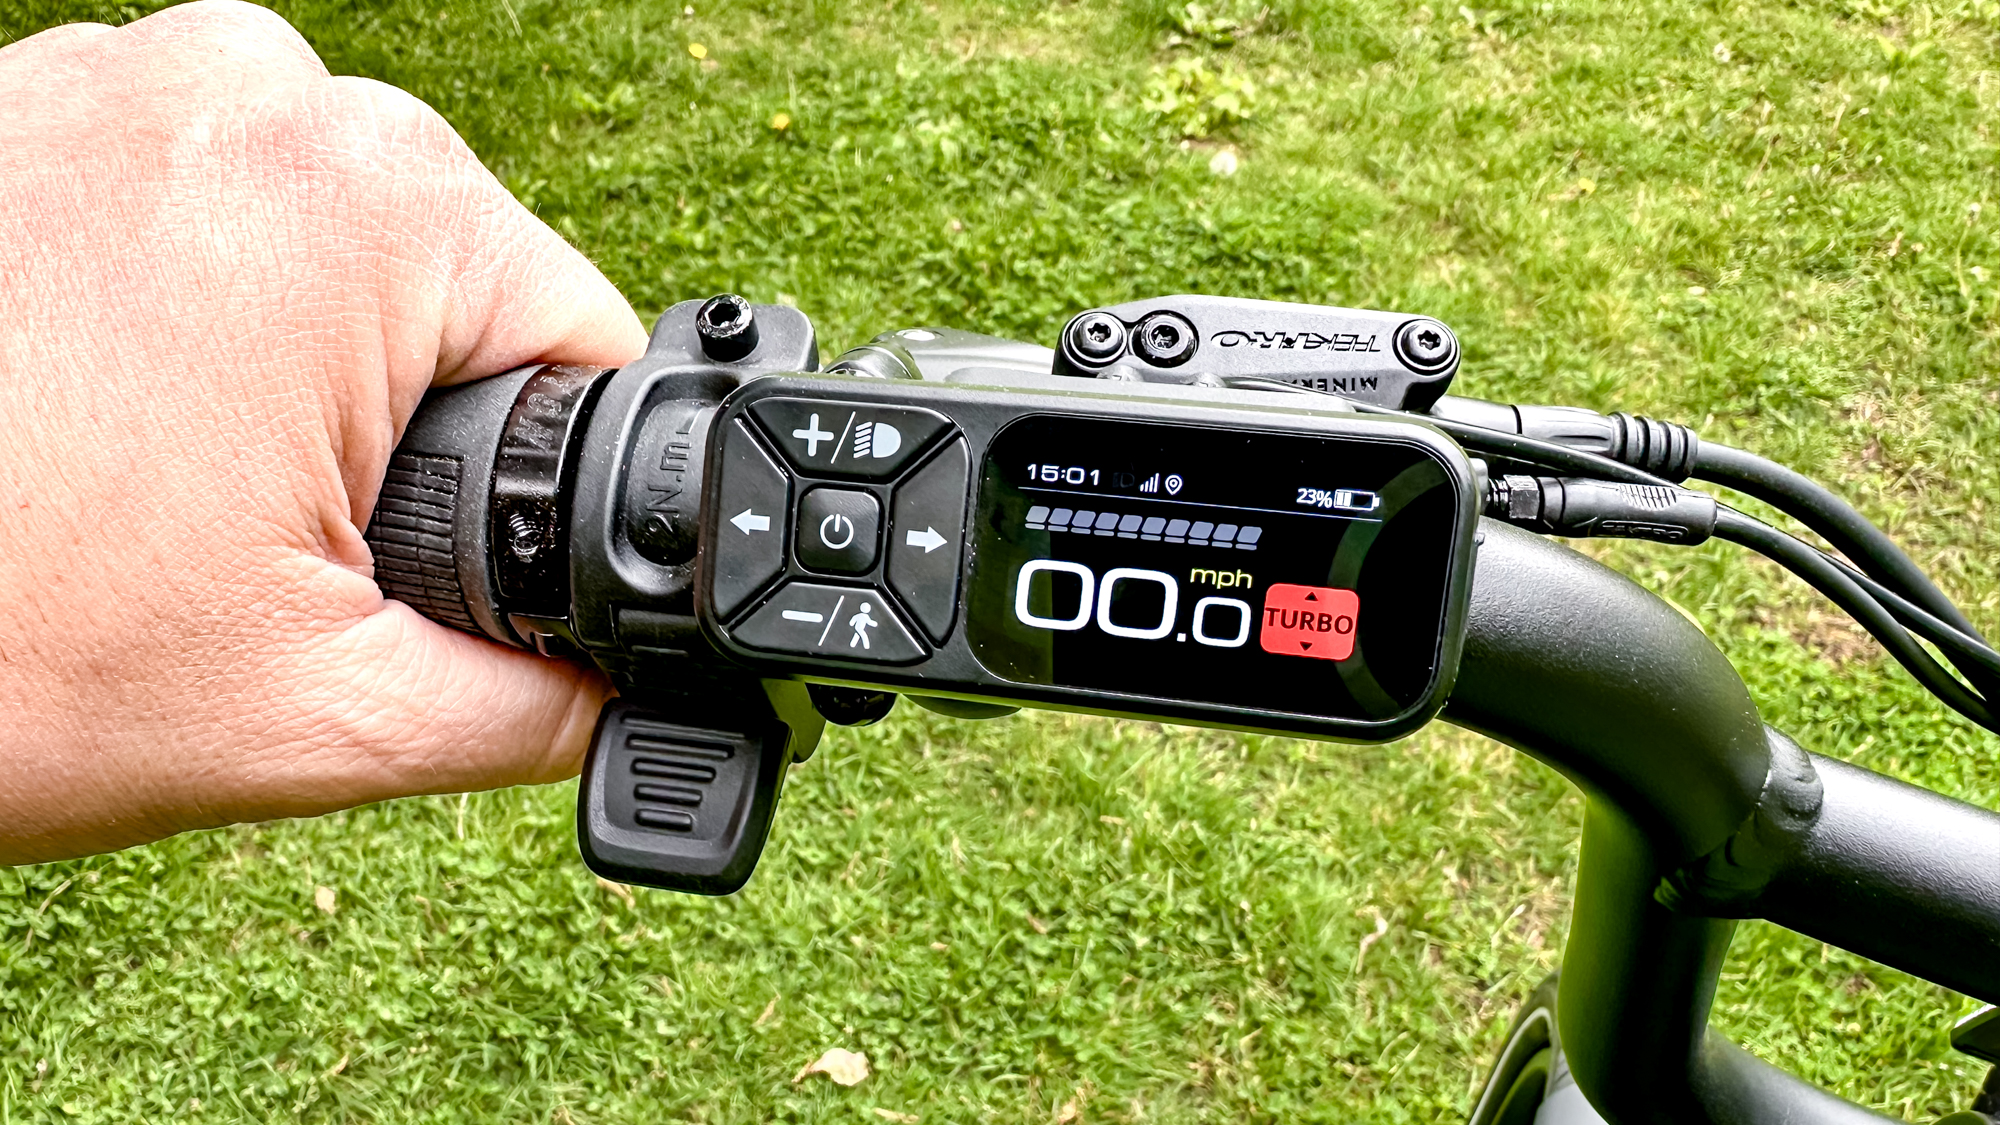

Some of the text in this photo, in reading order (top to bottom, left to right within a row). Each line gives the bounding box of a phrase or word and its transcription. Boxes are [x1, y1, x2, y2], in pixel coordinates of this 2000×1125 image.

[1281, 377, 1378, 394] MINER
[1027, 463, 1100, 486] 15:01
[1296, 487, 1333, 508] 23%
[1014, 558, 1252, 648] 00.0 mph
[1264, 606, 1354, 635] TURBO
